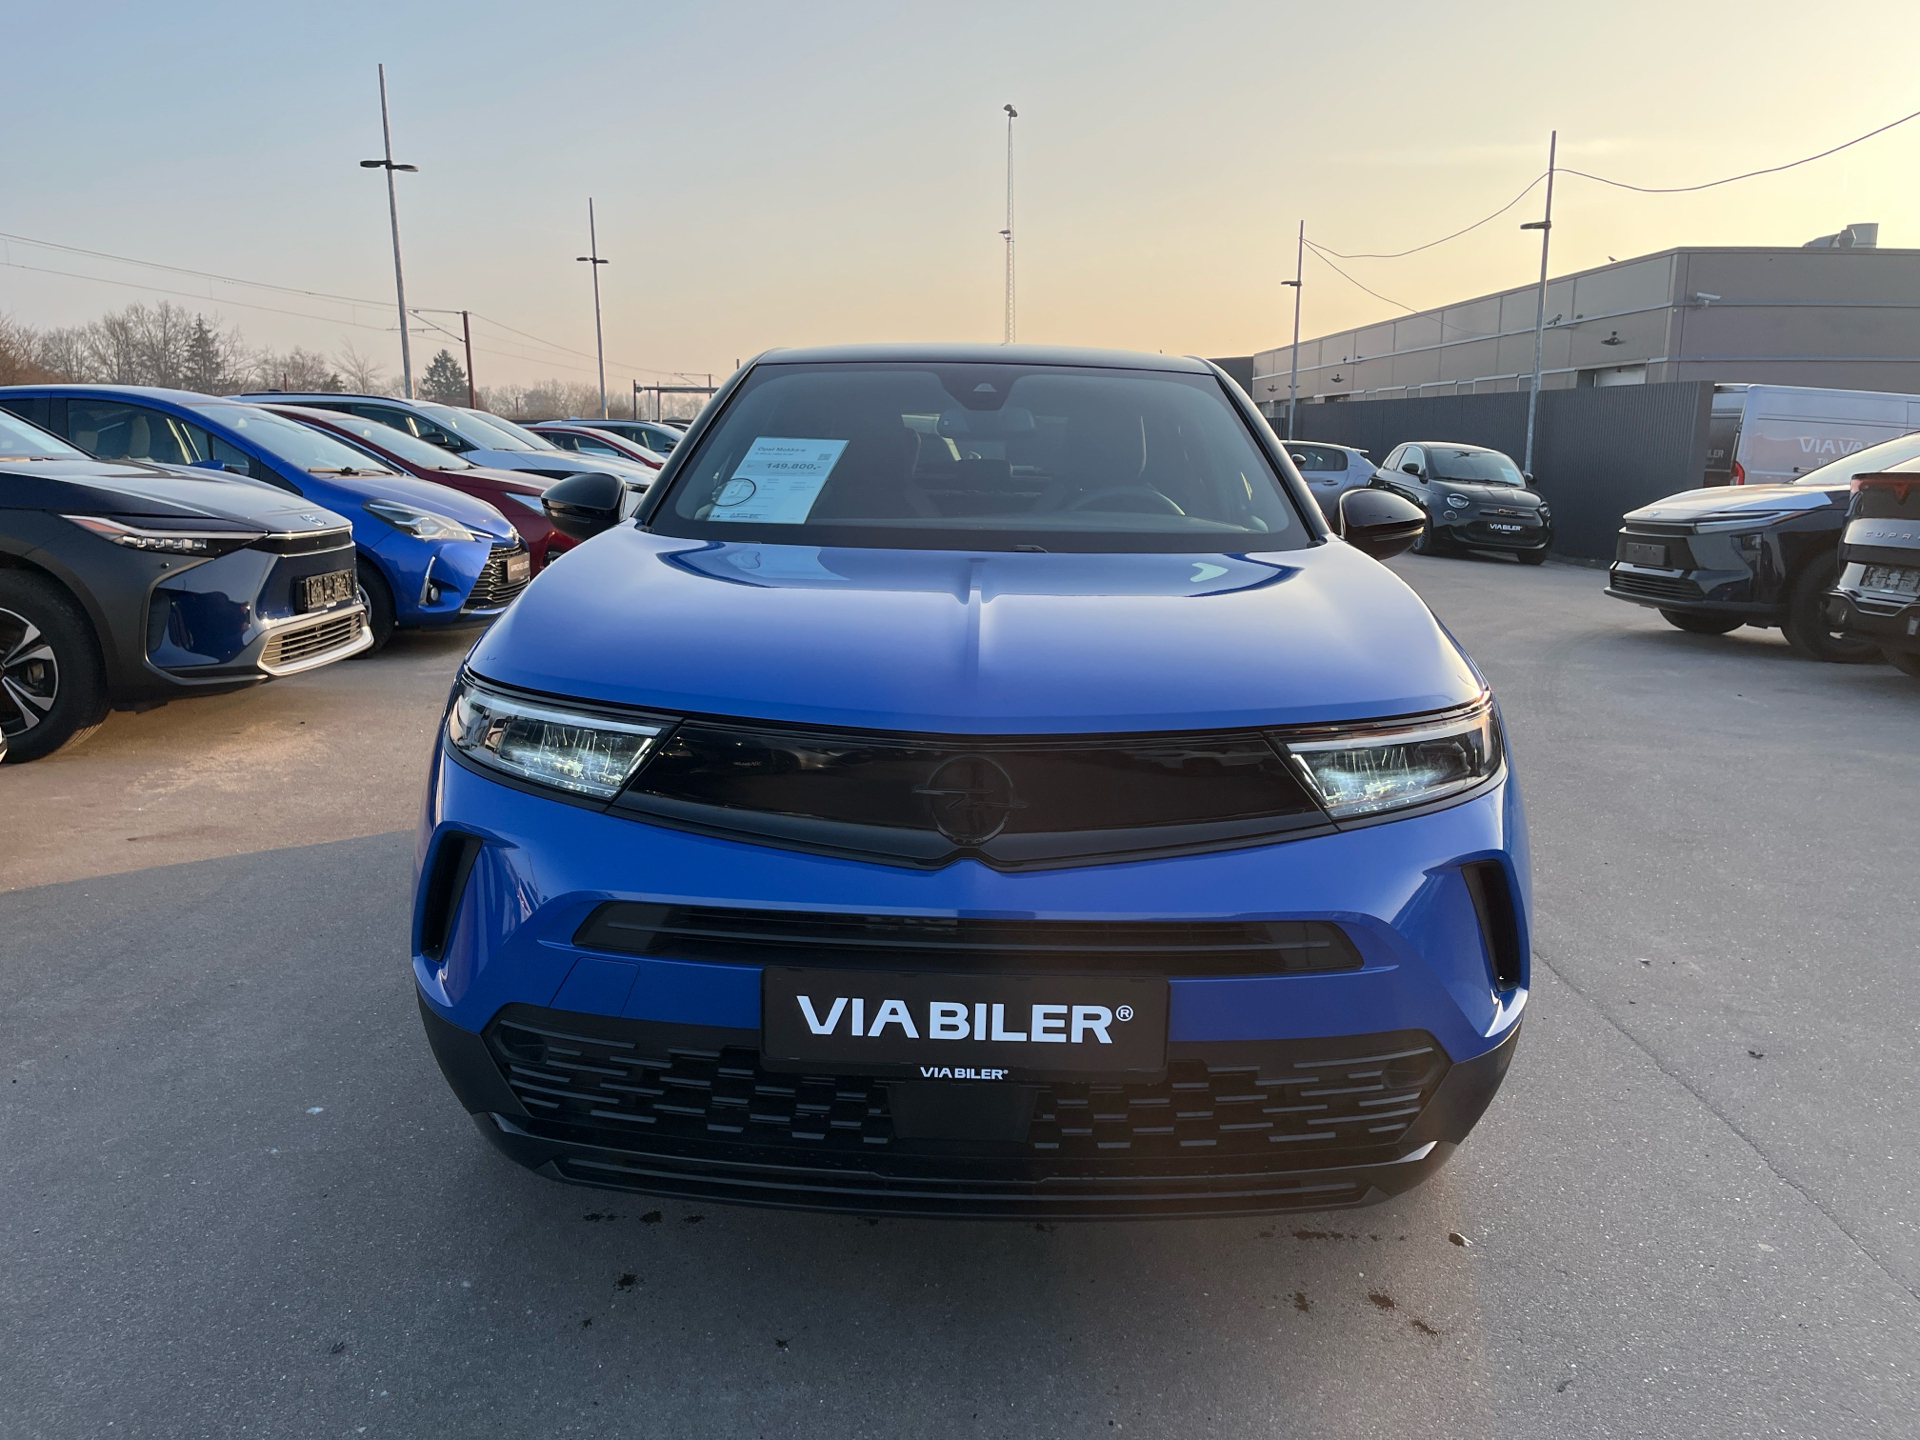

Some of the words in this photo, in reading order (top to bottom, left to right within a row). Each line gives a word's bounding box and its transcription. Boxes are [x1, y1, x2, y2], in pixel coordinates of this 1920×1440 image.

[1799, 438, 1836, 454] VIA
[1864, 530, 1920, 540] CUPR
[796, 995, 920, 1039] VIA
[920, 1066, 953, 1079] VIA
